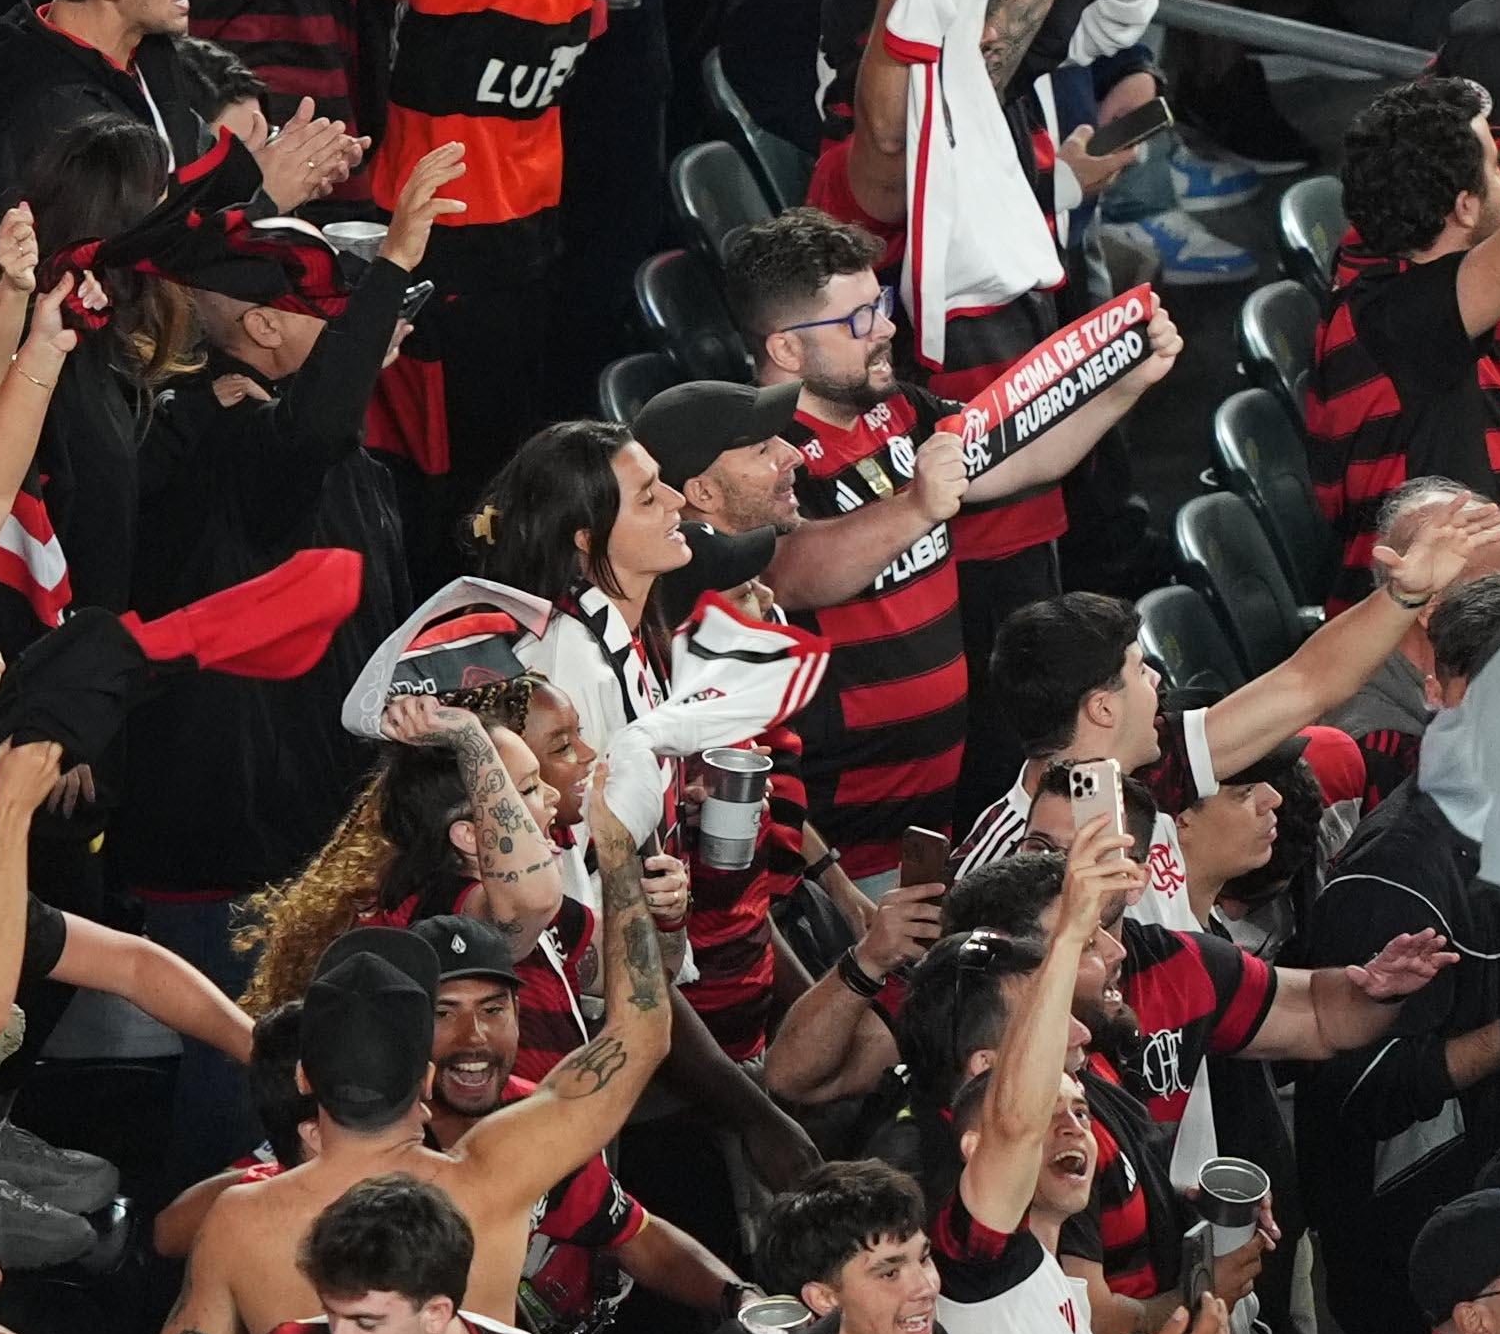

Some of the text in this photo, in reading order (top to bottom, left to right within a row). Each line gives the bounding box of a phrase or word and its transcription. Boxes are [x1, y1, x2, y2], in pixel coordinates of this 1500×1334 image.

[1003, 298, 1145, 412] ACIMA DE TUDO
[1014, 330, 1144, 442] RUBRO-NEGRO
